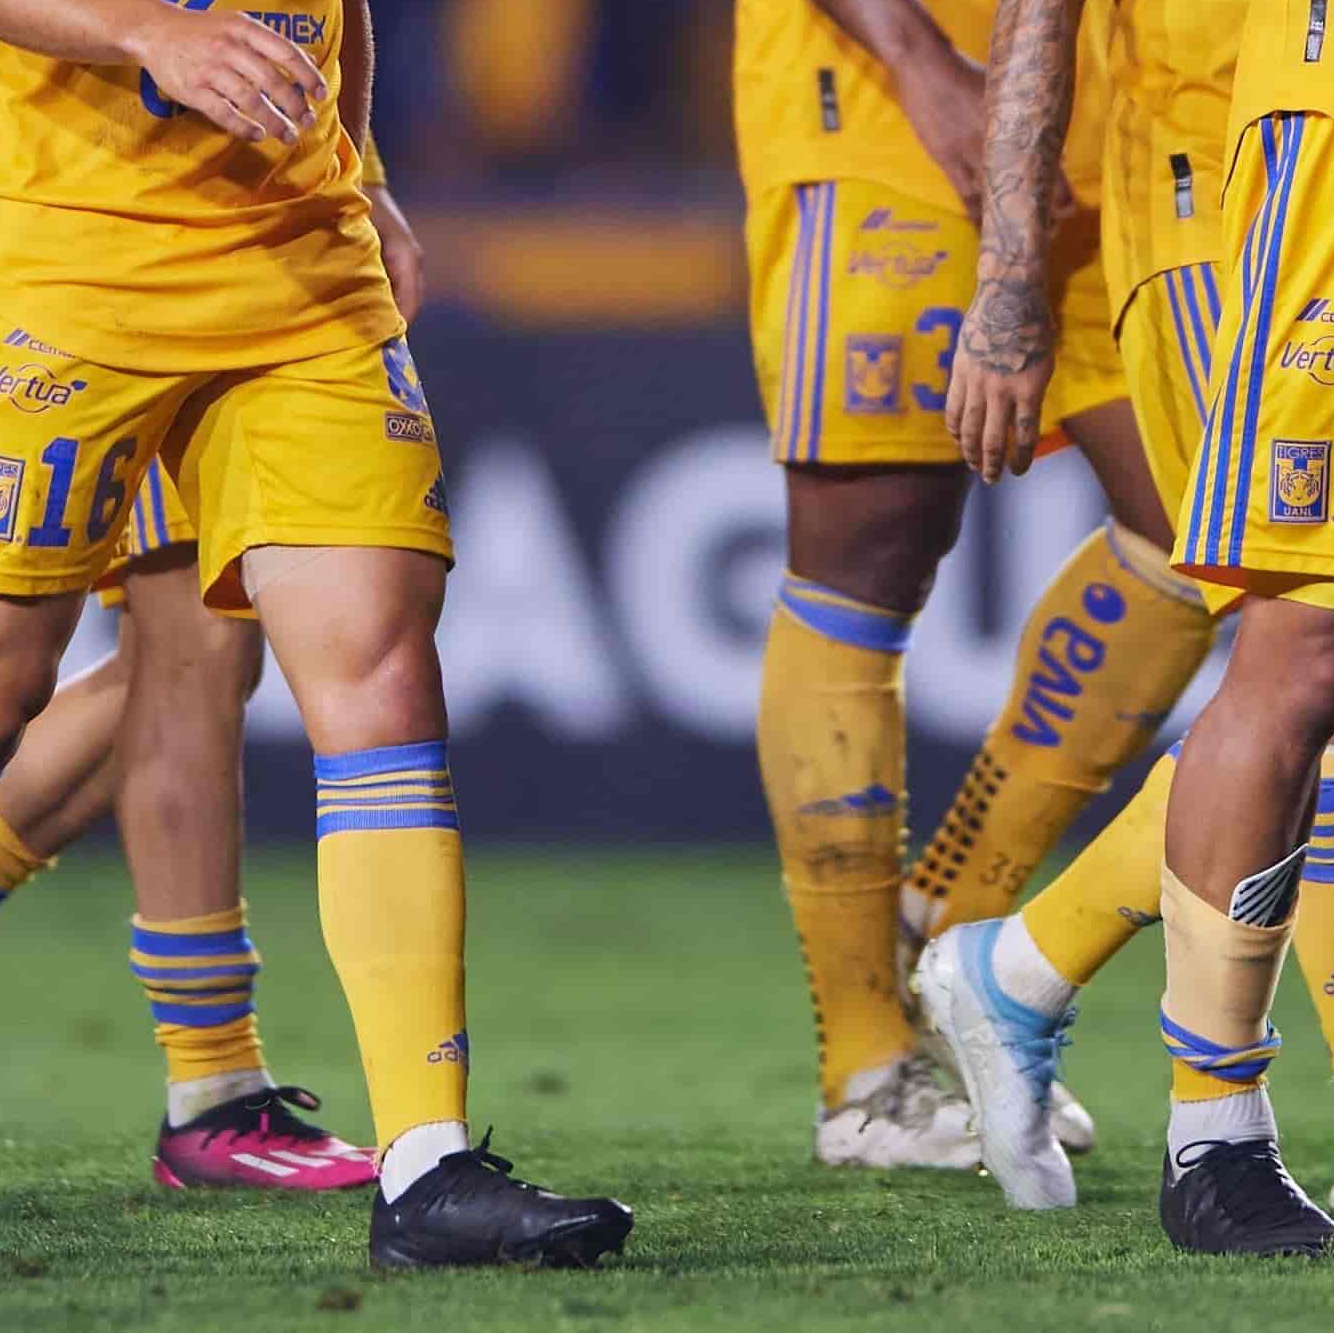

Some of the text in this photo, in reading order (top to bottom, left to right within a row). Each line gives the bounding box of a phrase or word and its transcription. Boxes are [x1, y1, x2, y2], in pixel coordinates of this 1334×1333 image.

[243, 12, 326, 44] MEX
[1278, 446, 1324, 459] TIGRES
[27, 436, 138, 546] 16
[1283, 506, 1313, 516] UANL
